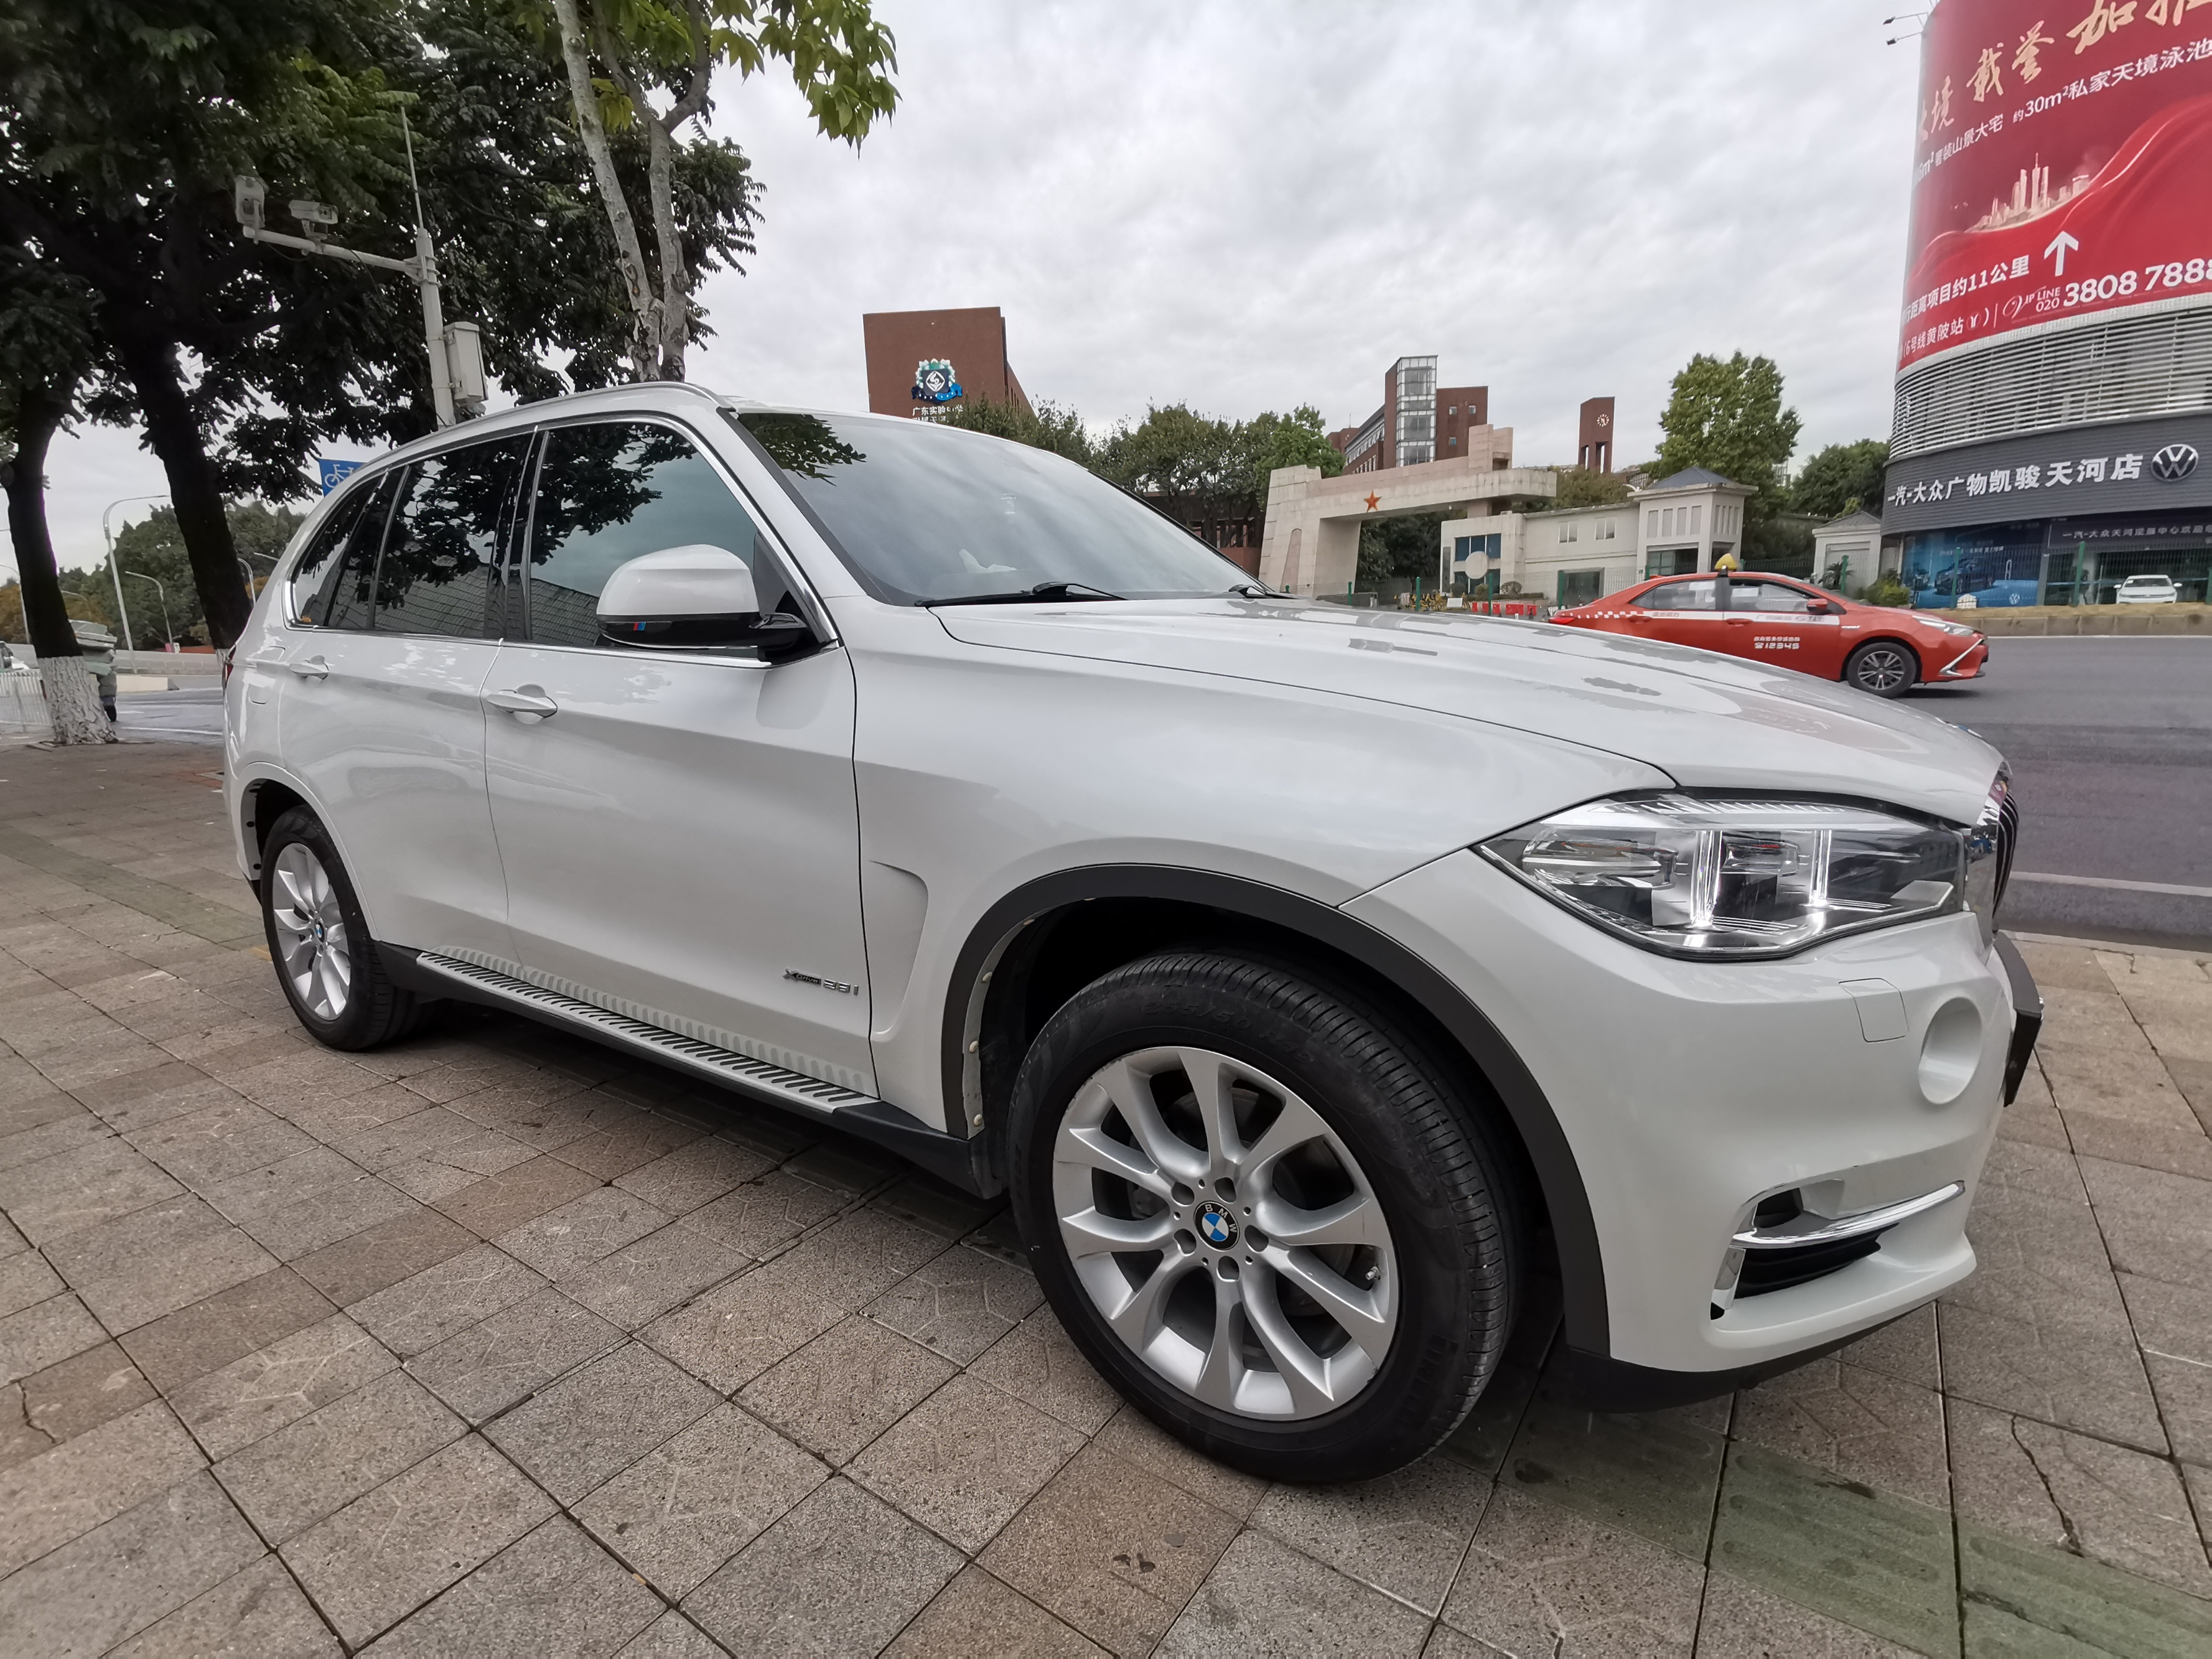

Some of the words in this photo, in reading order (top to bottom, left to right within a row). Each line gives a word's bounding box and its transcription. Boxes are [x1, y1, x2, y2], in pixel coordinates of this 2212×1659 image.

[2036, 298, 2060, 312] 020
[2064, 270, 2137, 306] 3808
[2037, 287, 2061, 302] LINE
[1887, 454, 2143, 506] 一汽-大众广物凯骏天河店
[1205, 1203, 1238, 1233] BMW
